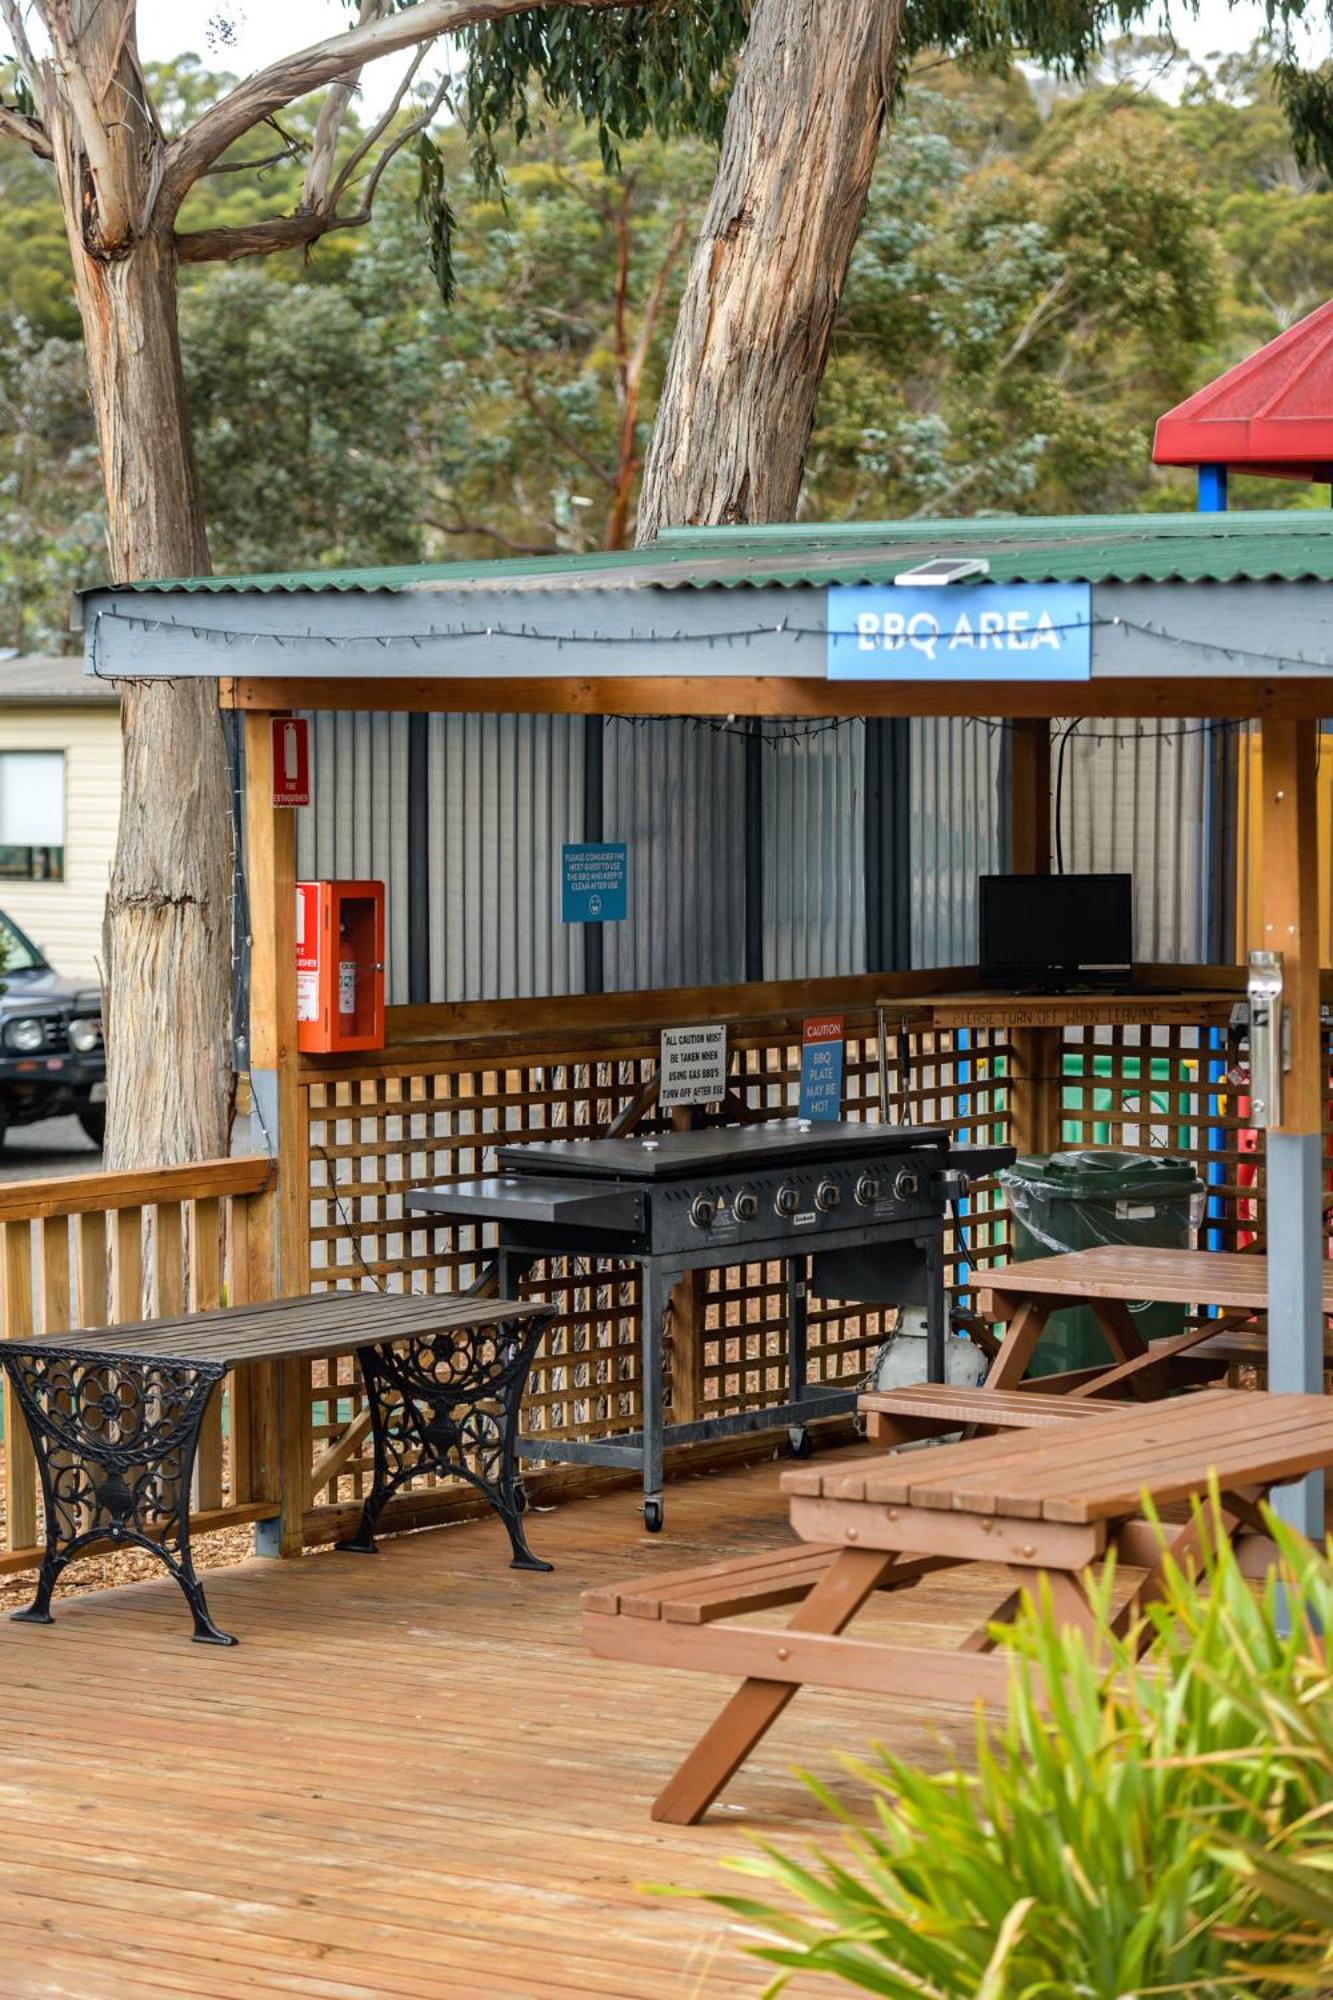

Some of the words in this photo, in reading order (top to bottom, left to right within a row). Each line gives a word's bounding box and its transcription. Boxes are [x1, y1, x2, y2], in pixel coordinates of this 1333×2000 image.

[857, 612, 939, 660] BBQ
[948, 610, 1061, 651] AREA
[565, 853, 585, 862] PLEASE
[608, 881, 619, 889] USE
[953, 1011, 993, 1025] PLEASE
[1000, 1008, 1034, 1025] TURN
[1065, 1007, 1100, 1024] WHEN
[1107, 1005, 1160, 1024] LEAVING
[807, 1023, 842, 1038] CAUTION
[666, 1035, 677, 1046] ALL
[678, 1033, 705, 1045] CAUTION
[706, 1032, 722, 1043] MUST
[670, 1053, 679, 1064] BE
[680, 1051, 700, 1063] TAKEN
[701, 1050, 718, 1061] WHEN
[813, 1051, 832, 1066] BBQ
[669, 1070, 688, 1082] USING
[688, 1069, 701, 1079] GAS
[809, 1067, 834, 1081] PLATE
[662, 1088, 679, 1099] TURN
[679, 1087, 692, 1098] OFF
[693, 1086, 712, 1096] AFTER
[713, 1084, 724, 1095] USE
[805, 1085, 825, 1098] MAY
[825, 1082, 837, 1095] BE
[811, 1100, 829, 1113] HOT
